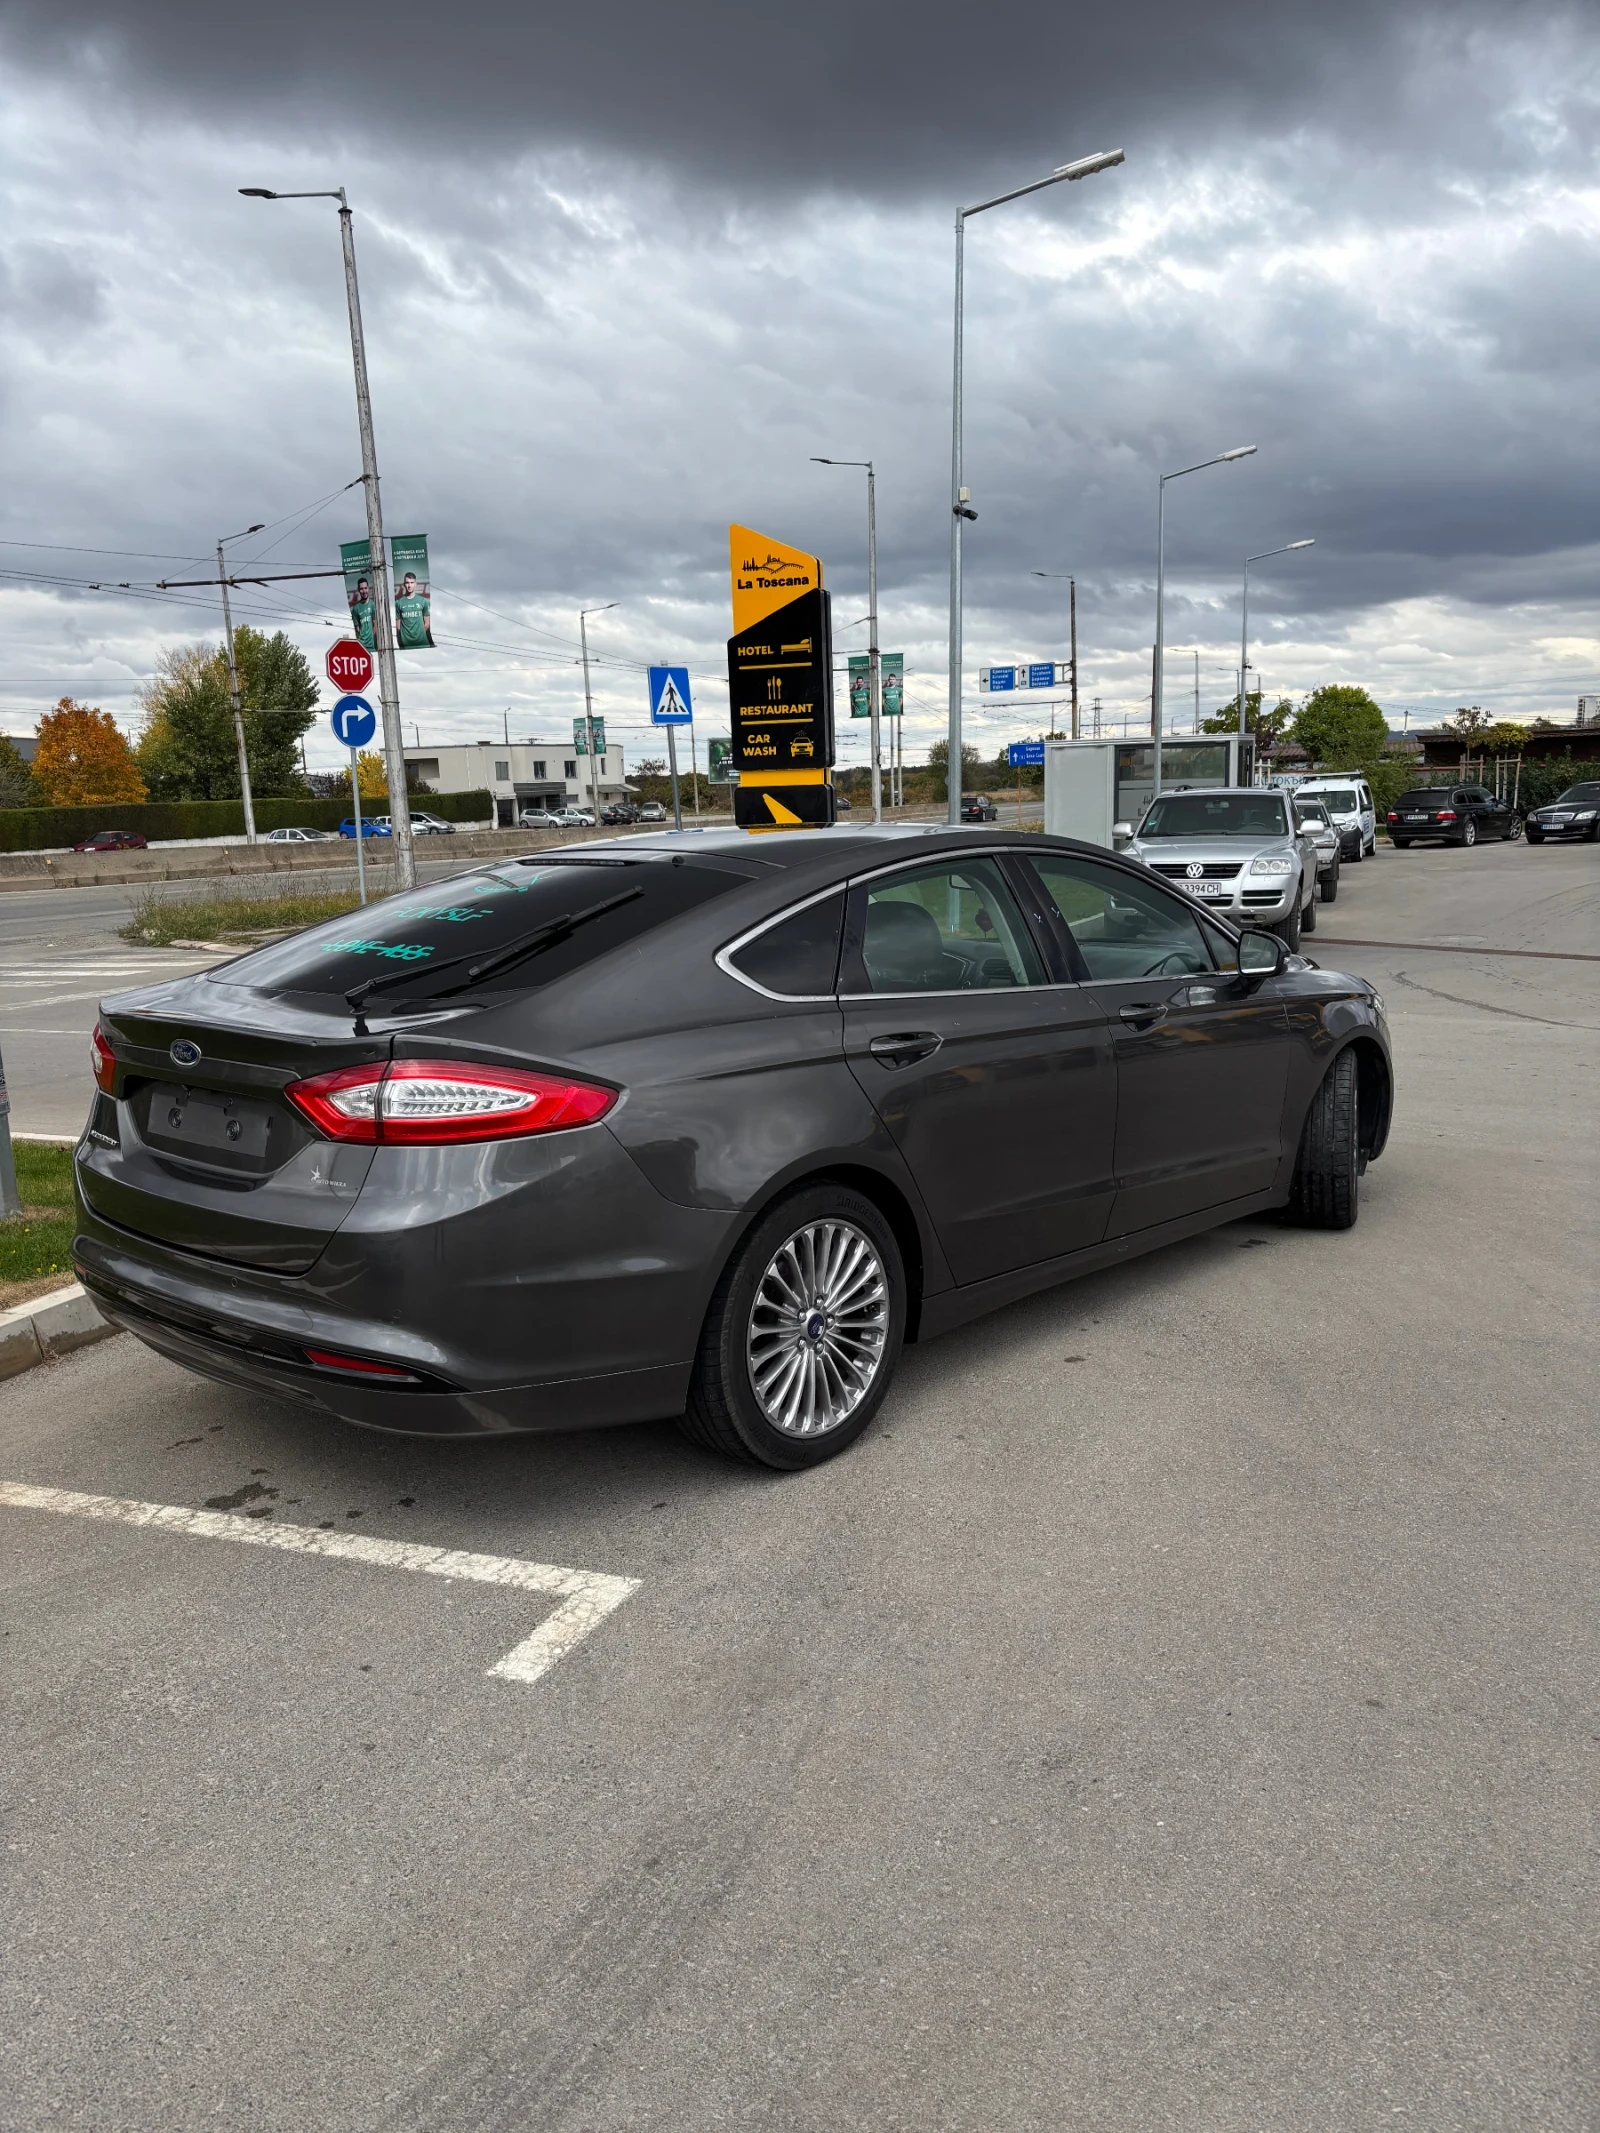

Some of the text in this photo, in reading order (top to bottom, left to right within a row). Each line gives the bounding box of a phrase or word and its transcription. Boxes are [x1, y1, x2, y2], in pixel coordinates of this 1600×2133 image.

[737, 577, 809, 589] La Toscana
[737, 646, 774, 656] HOTEL
[332, 656, 368, 675] STOP
[740, 704, 813, 716] RESTAURANT
[747, 734, 770, 743] CAR
[743, 747, 777, 756] WASH
[1206, 884, 1219, 893] CH
